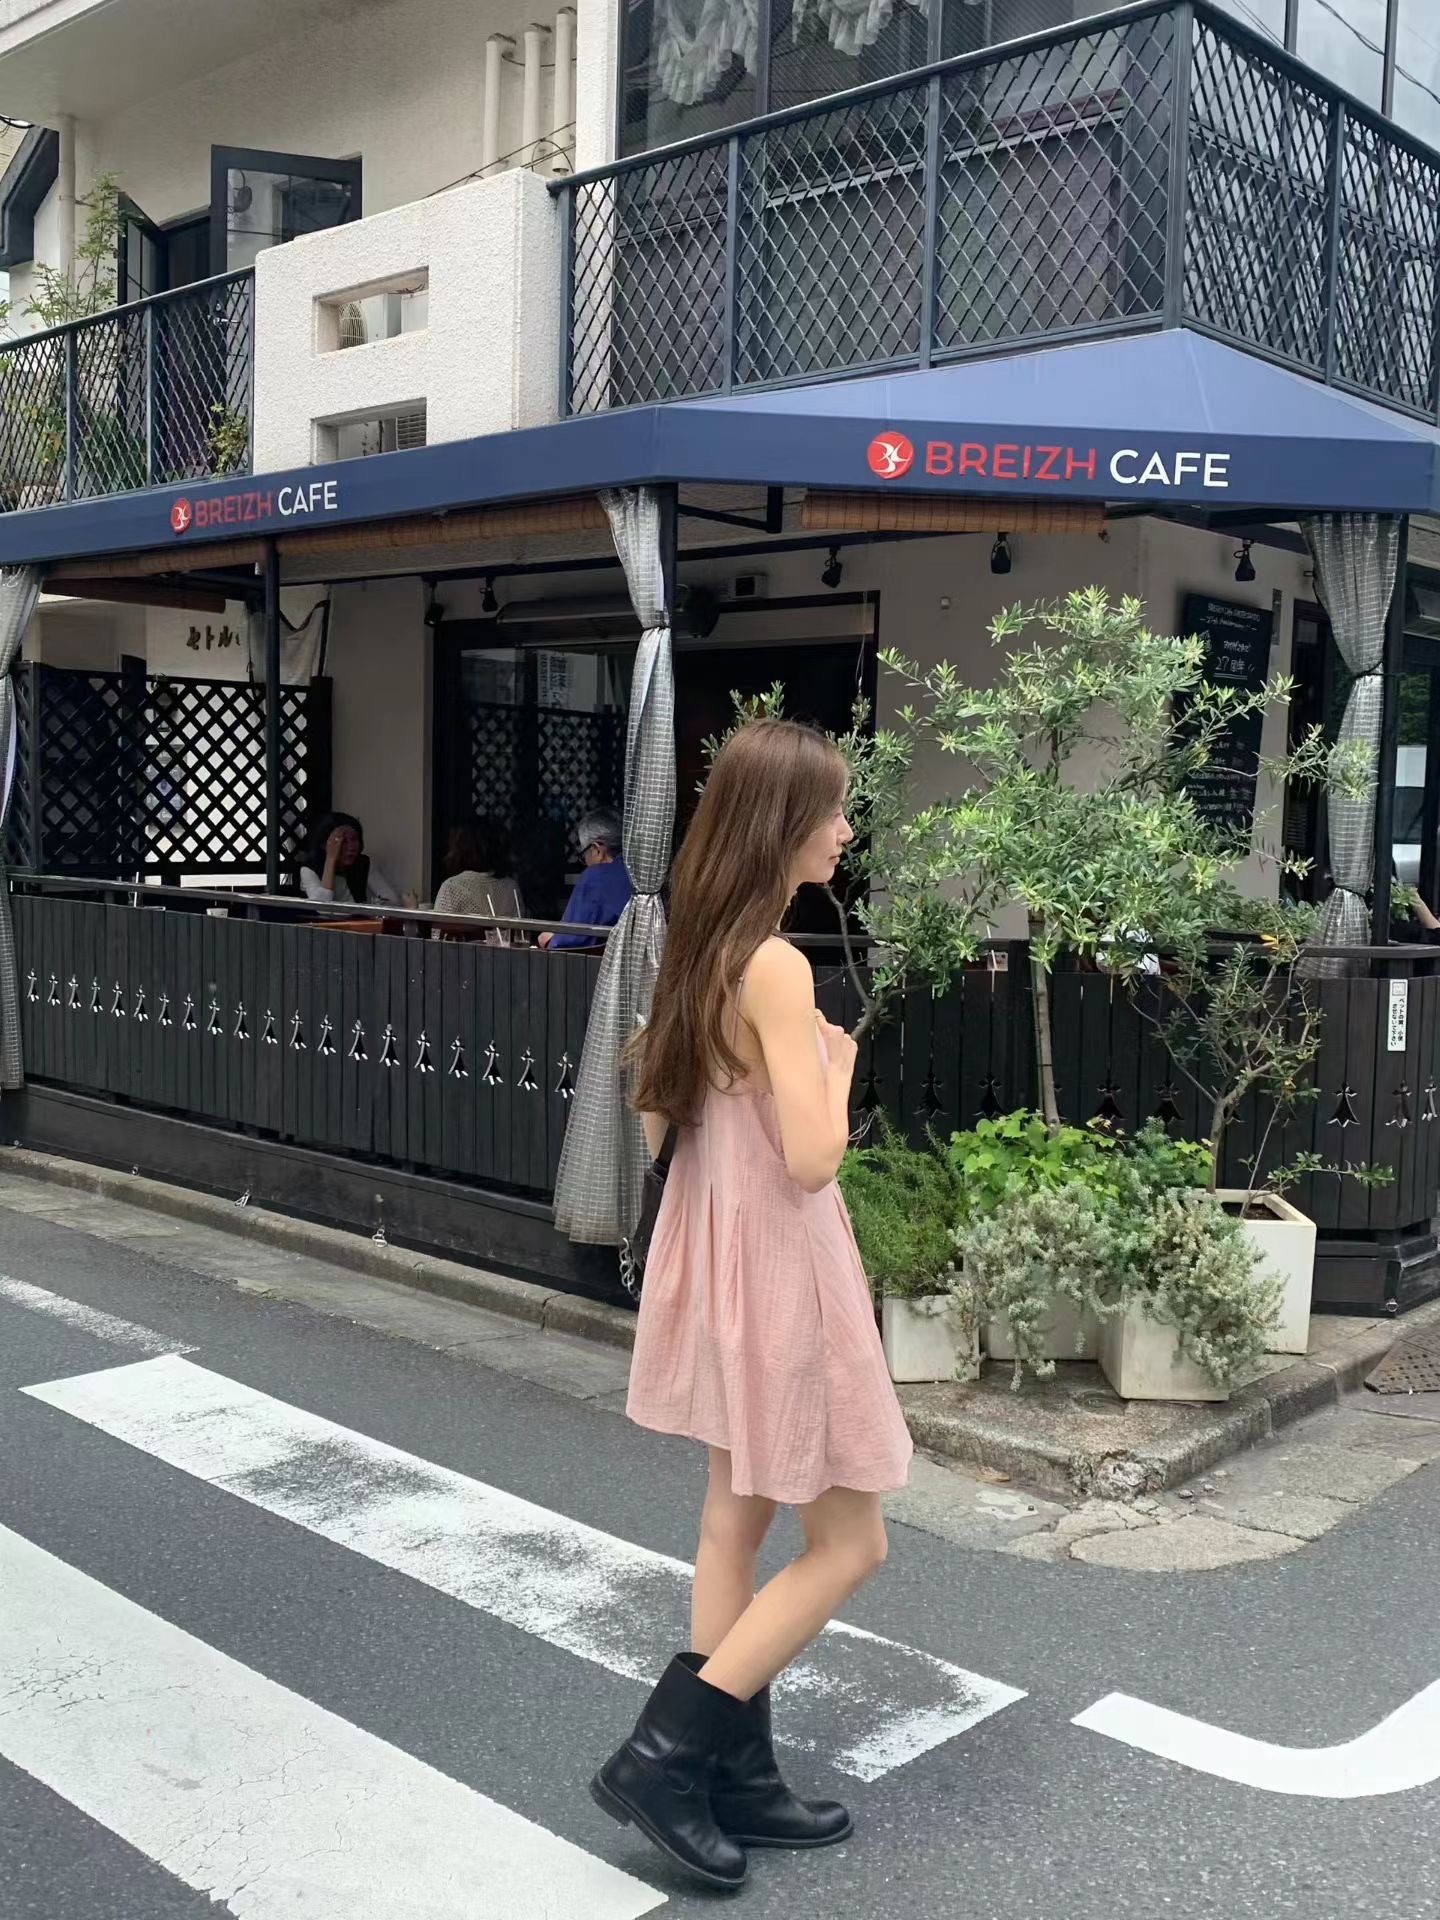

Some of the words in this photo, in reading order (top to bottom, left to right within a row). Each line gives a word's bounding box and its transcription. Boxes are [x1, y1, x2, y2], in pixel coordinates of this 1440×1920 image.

[925, 440, 1096, 481] BREIZH
[1109, 449, 1231, 487] CAFE
[195, 490, 272, 528] BREIZH
[278, 480, 338, 516] CAFE
